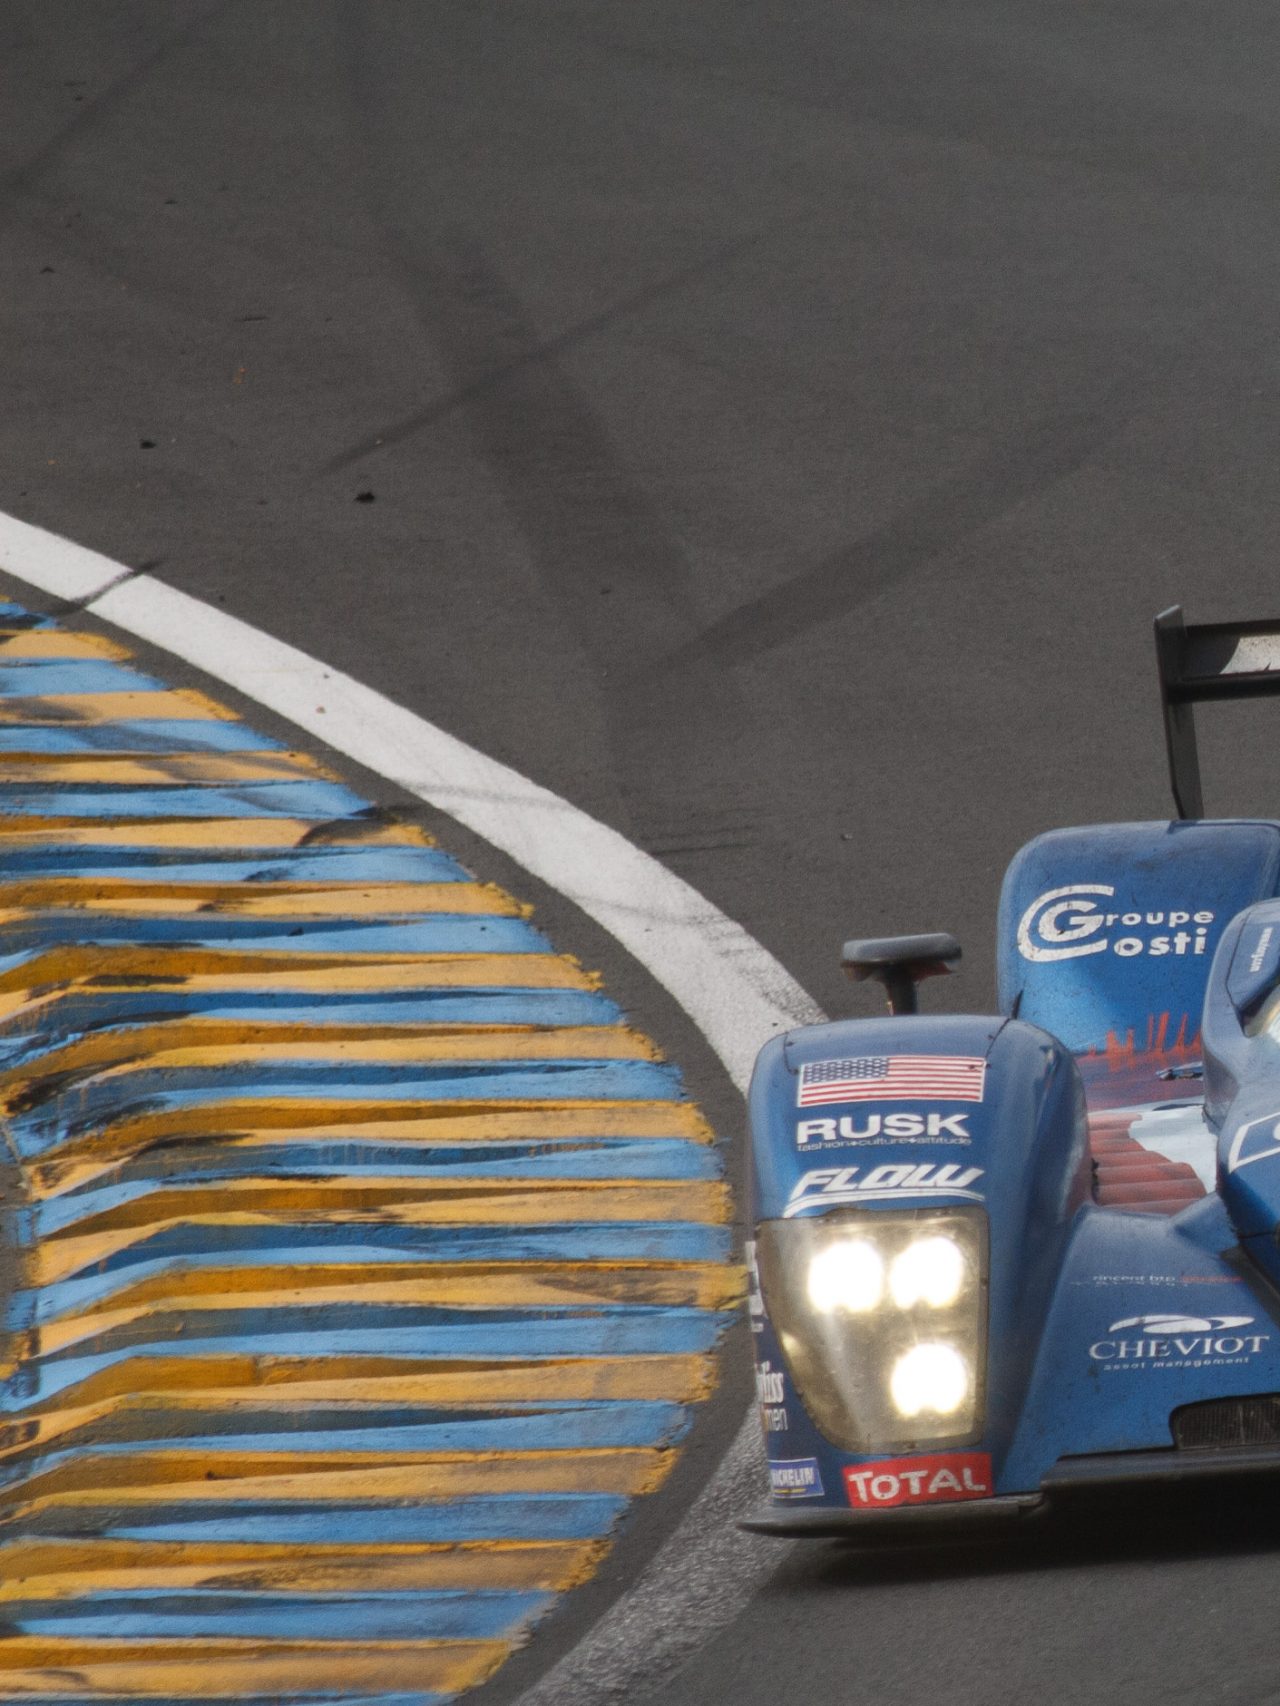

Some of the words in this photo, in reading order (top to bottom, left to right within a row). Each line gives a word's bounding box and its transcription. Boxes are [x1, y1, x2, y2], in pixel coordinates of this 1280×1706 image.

[797, 1113, 970, 1144] RUSK
[789, 1163, 985, 1201] FLOW
[1088, 1336, 1270, 1360] CHEVIOT
[848, 1467, 987, 1503] TOTAL
